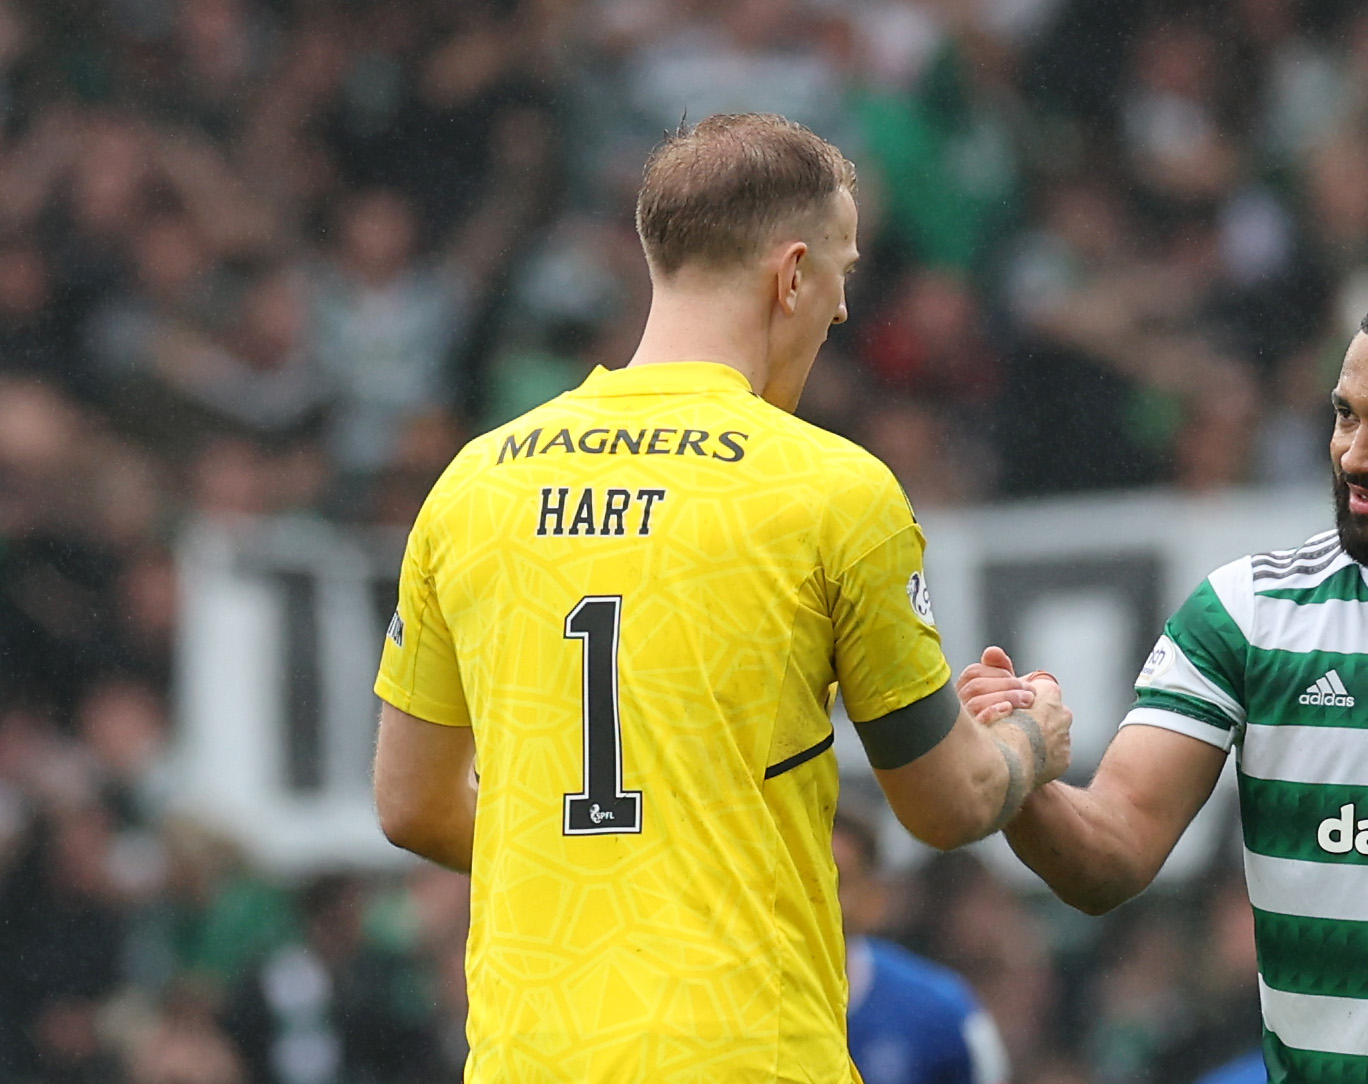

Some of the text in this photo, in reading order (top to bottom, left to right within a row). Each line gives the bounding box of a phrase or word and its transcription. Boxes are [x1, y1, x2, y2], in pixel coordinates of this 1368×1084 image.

[496, 428, 749, 466] MAGNERS
[536, 488, 667, 536] HART
[563, 594, 643, 837] 1
[1298, 691, 1355, 708] adidas
